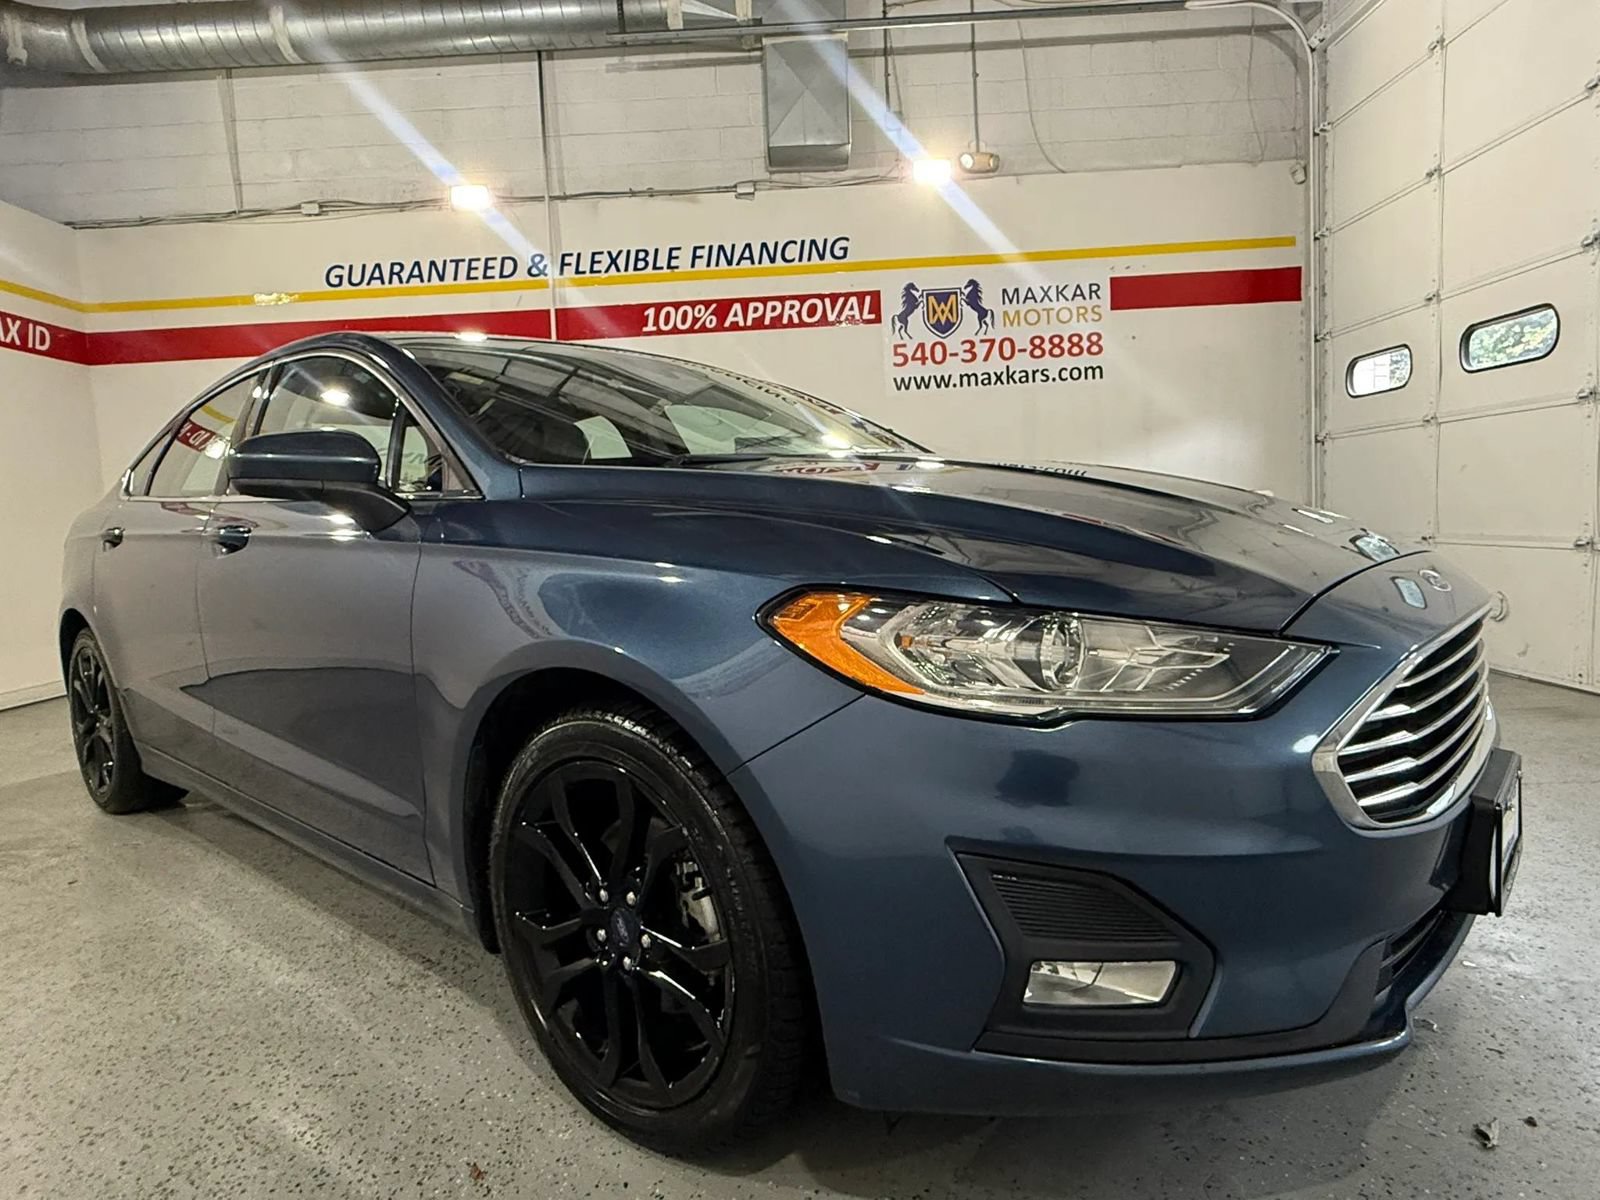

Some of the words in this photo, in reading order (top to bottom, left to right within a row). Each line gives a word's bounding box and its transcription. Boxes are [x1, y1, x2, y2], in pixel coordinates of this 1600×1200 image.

[325, 256, 518, 288] GUARANTEED
[527, 253, 548, 278] &
[559, 247, 682, 276] FLEXIBLE
[690, 236, 850, 269] FINANCING
[1001, 283, 1102, 305] MAXKAR
[642, 303, 717, 332] 100%
[723, 295, 876, 328] APPROVAL
[1002, 305, 1103, 328] MOTORS
[28, 322, 51, 351] ID
[892, 331, 1104, 367] 540-370-8888
[893, 365, 1104, 391] www.maxkars.com
